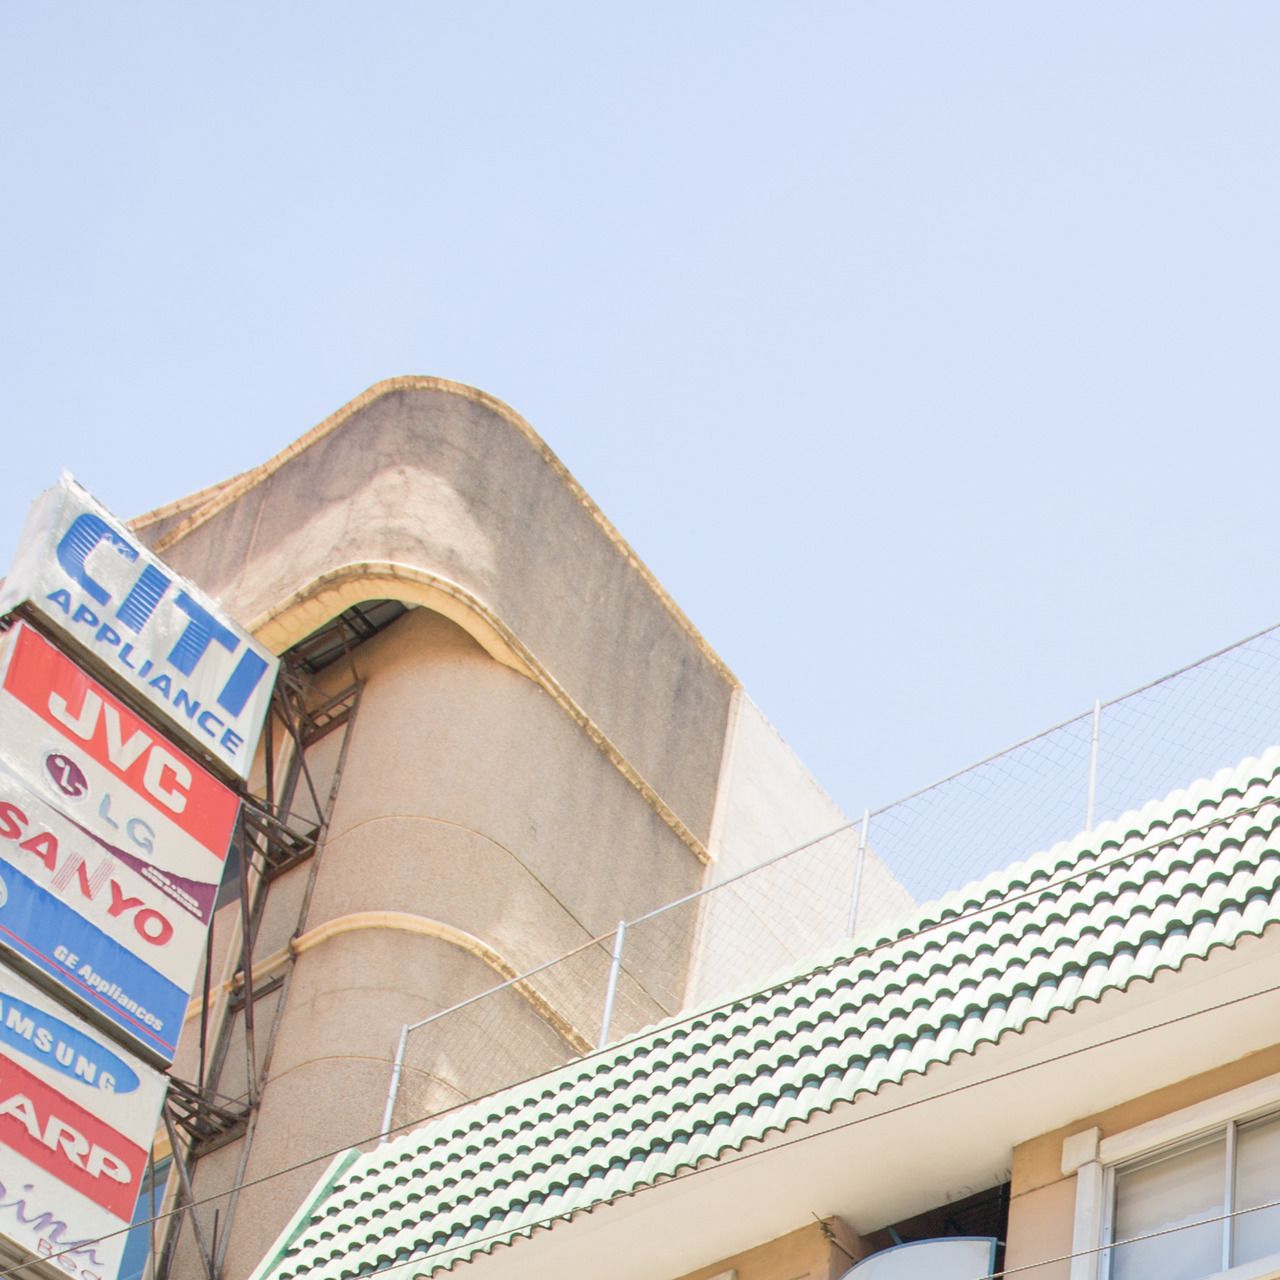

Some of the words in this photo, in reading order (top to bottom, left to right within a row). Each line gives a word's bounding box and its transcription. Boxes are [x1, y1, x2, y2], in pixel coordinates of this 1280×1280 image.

[56, 513, 269, 719] CITI
[46, 588, 244, 755] APPLIANCE
[48, 688, 192, 814] JVC
[0, 801, 174, 946] SANYO
[98, 792, 156, 854] LG
[53, 945, 80, 970] GE
[78, 963, 164, 1032] Appliances
[0, 1001, 117, 1095] MSUNG
[0, 1182, 104, 1266] ina
